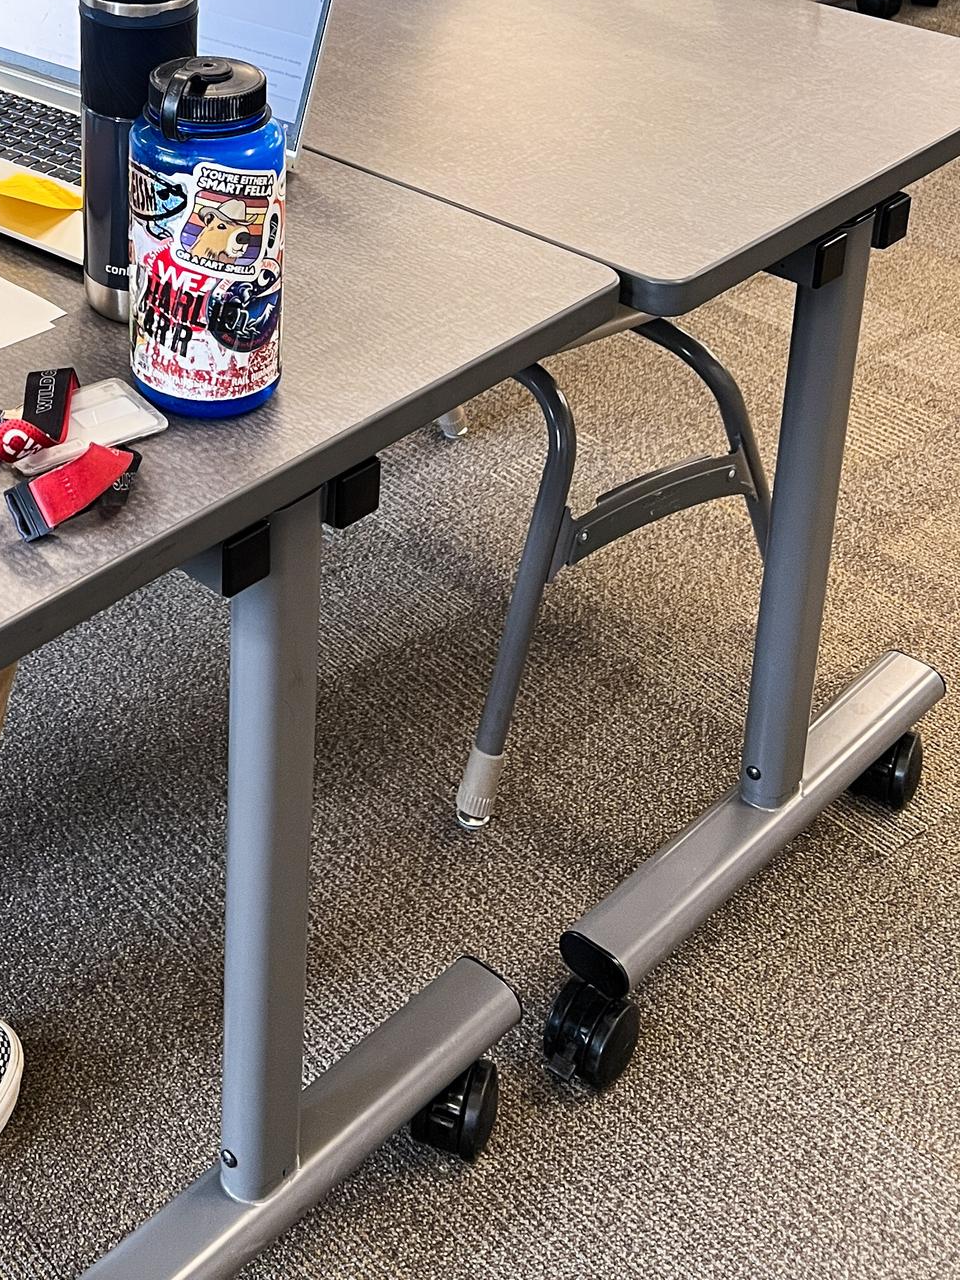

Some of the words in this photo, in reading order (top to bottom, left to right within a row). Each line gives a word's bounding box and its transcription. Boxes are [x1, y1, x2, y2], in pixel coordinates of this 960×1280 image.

[201, 167, 240, 184] YOU'RE
[240, 175, 267, 186] EITHER
[197, 177, 243, 196] SMART
[244, 185, 273, 197] FELLA
[176, 249, 191, 261] OR
[191, 255, 199, 265] A
[200, 258, 225, 271] FART
[225, 264, 255, 275] SMELLA
